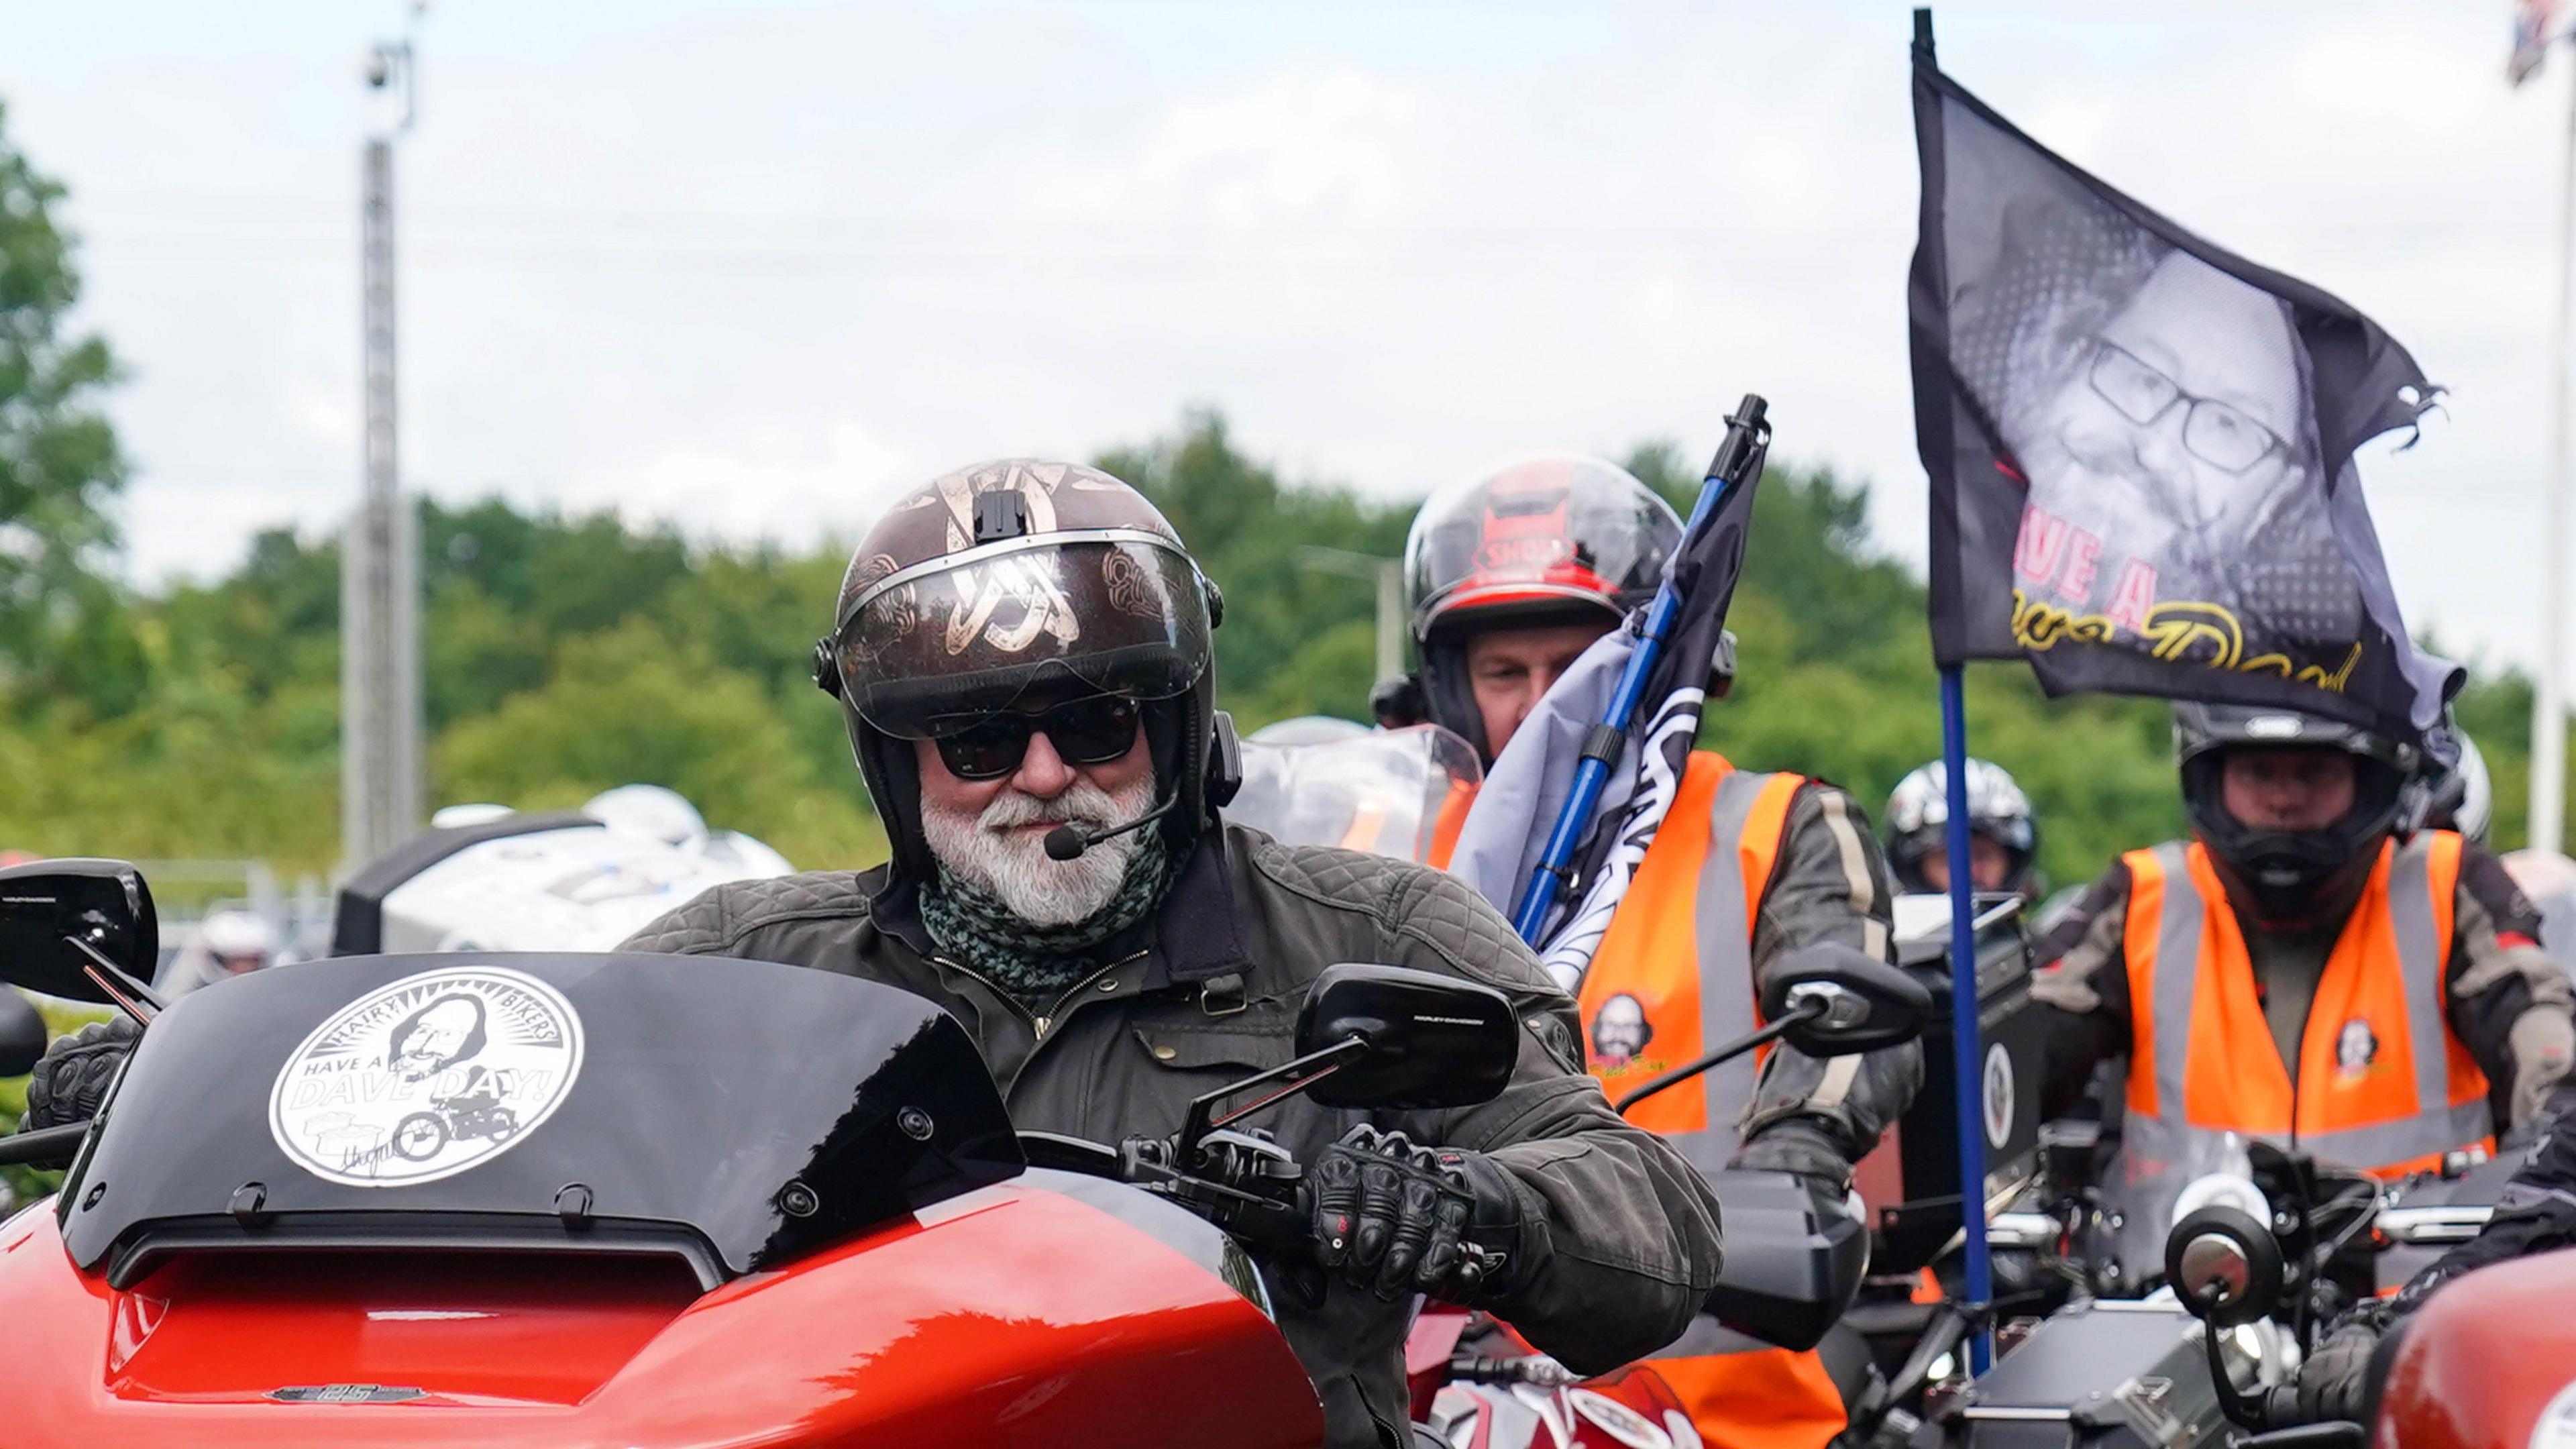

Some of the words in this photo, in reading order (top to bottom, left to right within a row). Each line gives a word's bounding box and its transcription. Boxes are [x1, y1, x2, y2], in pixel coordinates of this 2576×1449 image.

[1486, 539, 1562, 568] SHO
[2104, 555, 2159, 632] A
[331, 998, 396, 1044] HAIRY
[500, 994, 555, 1040] BIKERS
[303, 1057, 361, 1076] HAVE
[368, 1056, 382, 1069] A
[289, 1070, 416, 1110] DAVE
[431, 1067, 554, 1101] DAY!
